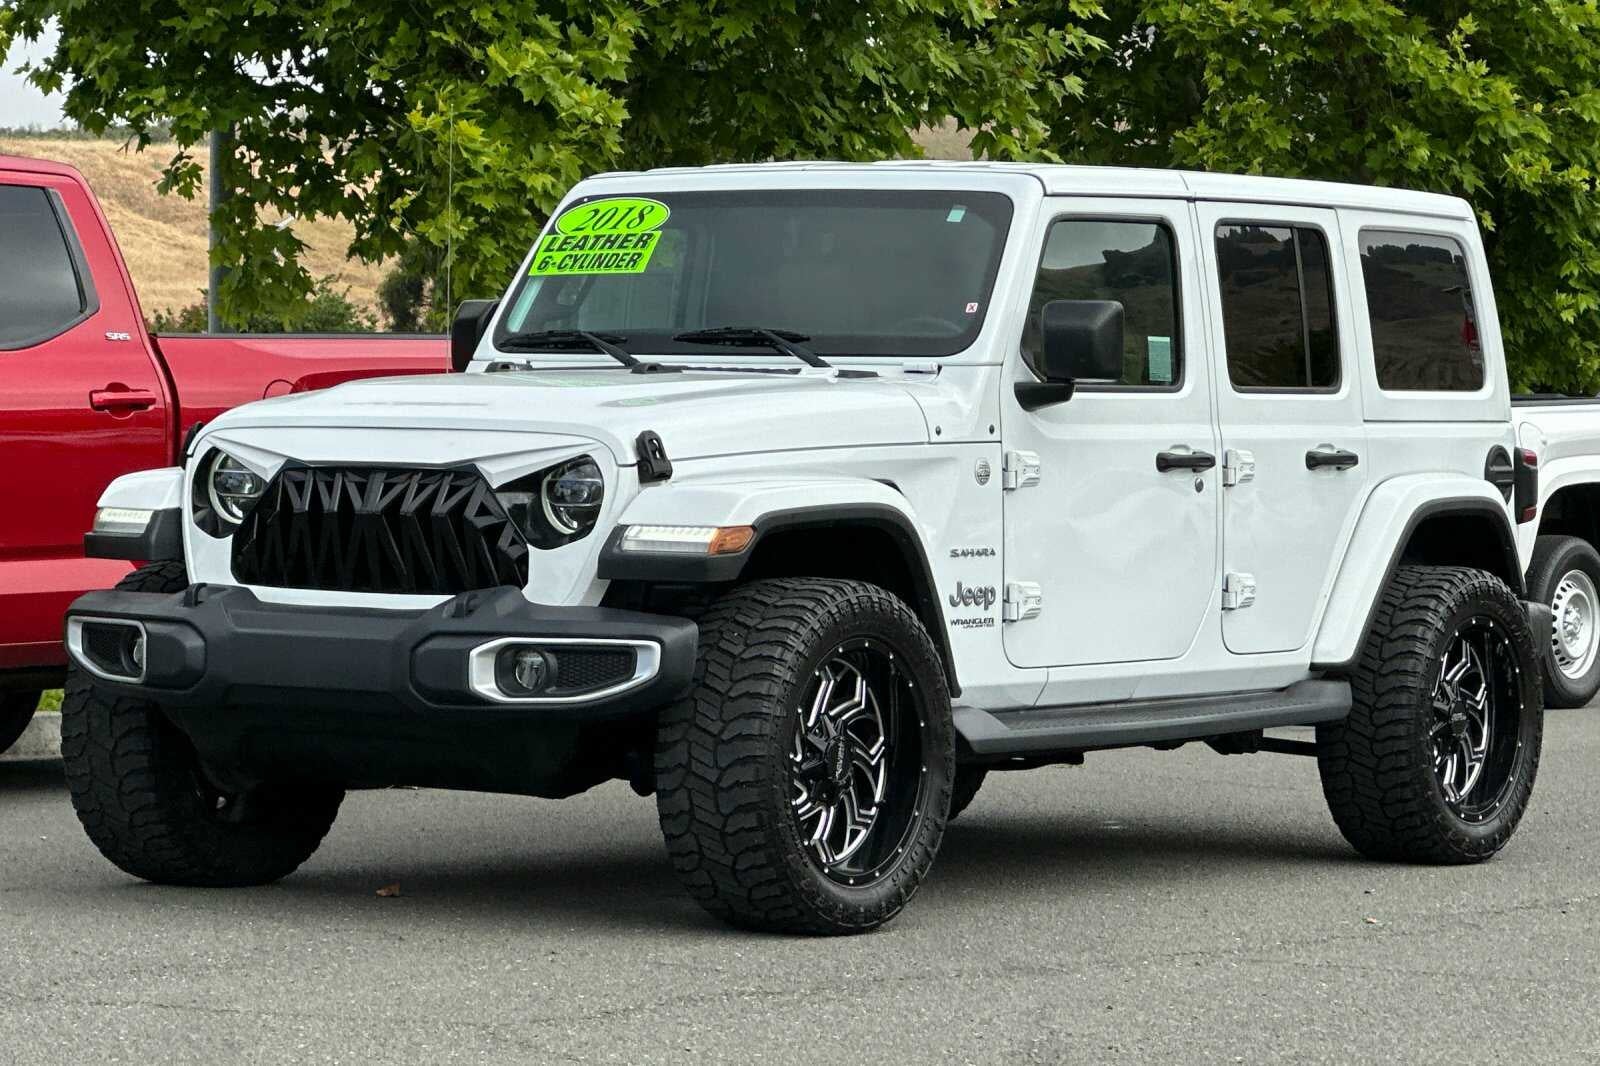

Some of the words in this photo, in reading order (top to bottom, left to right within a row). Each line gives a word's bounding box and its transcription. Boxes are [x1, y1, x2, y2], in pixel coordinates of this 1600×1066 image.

[571, 205, 654, 231] 2018
[544, 232, 653, 252] LEATHER
[537, 252, 642, 272] 6-CYLINDER
[949, 548, 996, 558] SAHARA
[949, 581, 996, 611] Jeep
[950, 617, 995, 626] WRANGLER
